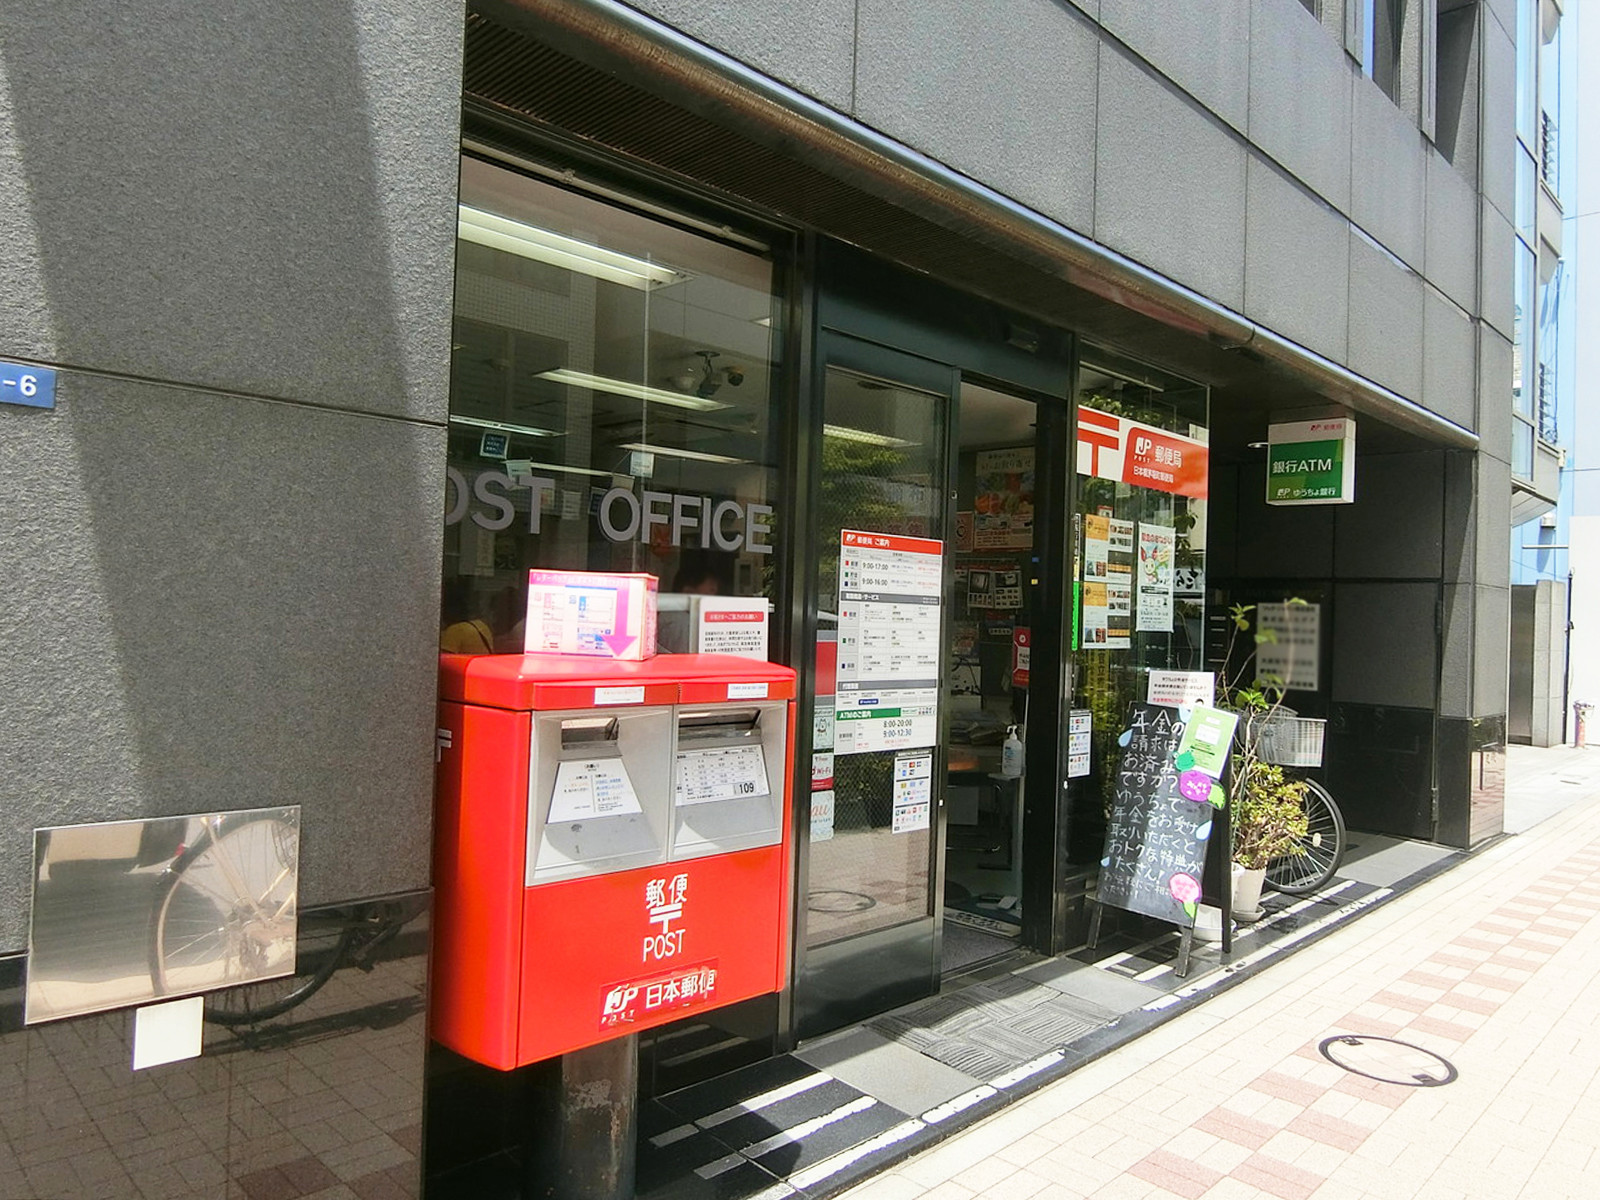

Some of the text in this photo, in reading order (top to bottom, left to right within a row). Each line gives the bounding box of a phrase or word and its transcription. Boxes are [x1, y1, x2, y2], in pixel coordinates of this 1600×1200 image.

[1155, 445, 1182, 468] 郵便局
[1272, 458, 1332, 474] 銀行ATM
[1293, 487, 1336, 496] ゆうちょ銀行
[600, 488, 773, 553] OFFICE
[883, 719, 913, 728] 8:00-20:00
[1131, 709, 1186, 736] 年金の
[1131, 734, 1178, 752] 請求は
[1124, 751, 1176, 774] お済み
[739, 782, 755, 794] 109
[1120, 771, 1178, 793] ですが?
[1116, 789, 1186, 813] ゆうちょで
[1114, 805, 1198, 835] 年金をお受け
[1110, 823, 1196, 855] 取りいただくと
[1108, 839, 1204, 874] おトクな特典が
[645, 873, 689, 909] 郵便
[643, 929, 686, 962] POST
[645, 969, 716, 1009] 日本郵便
